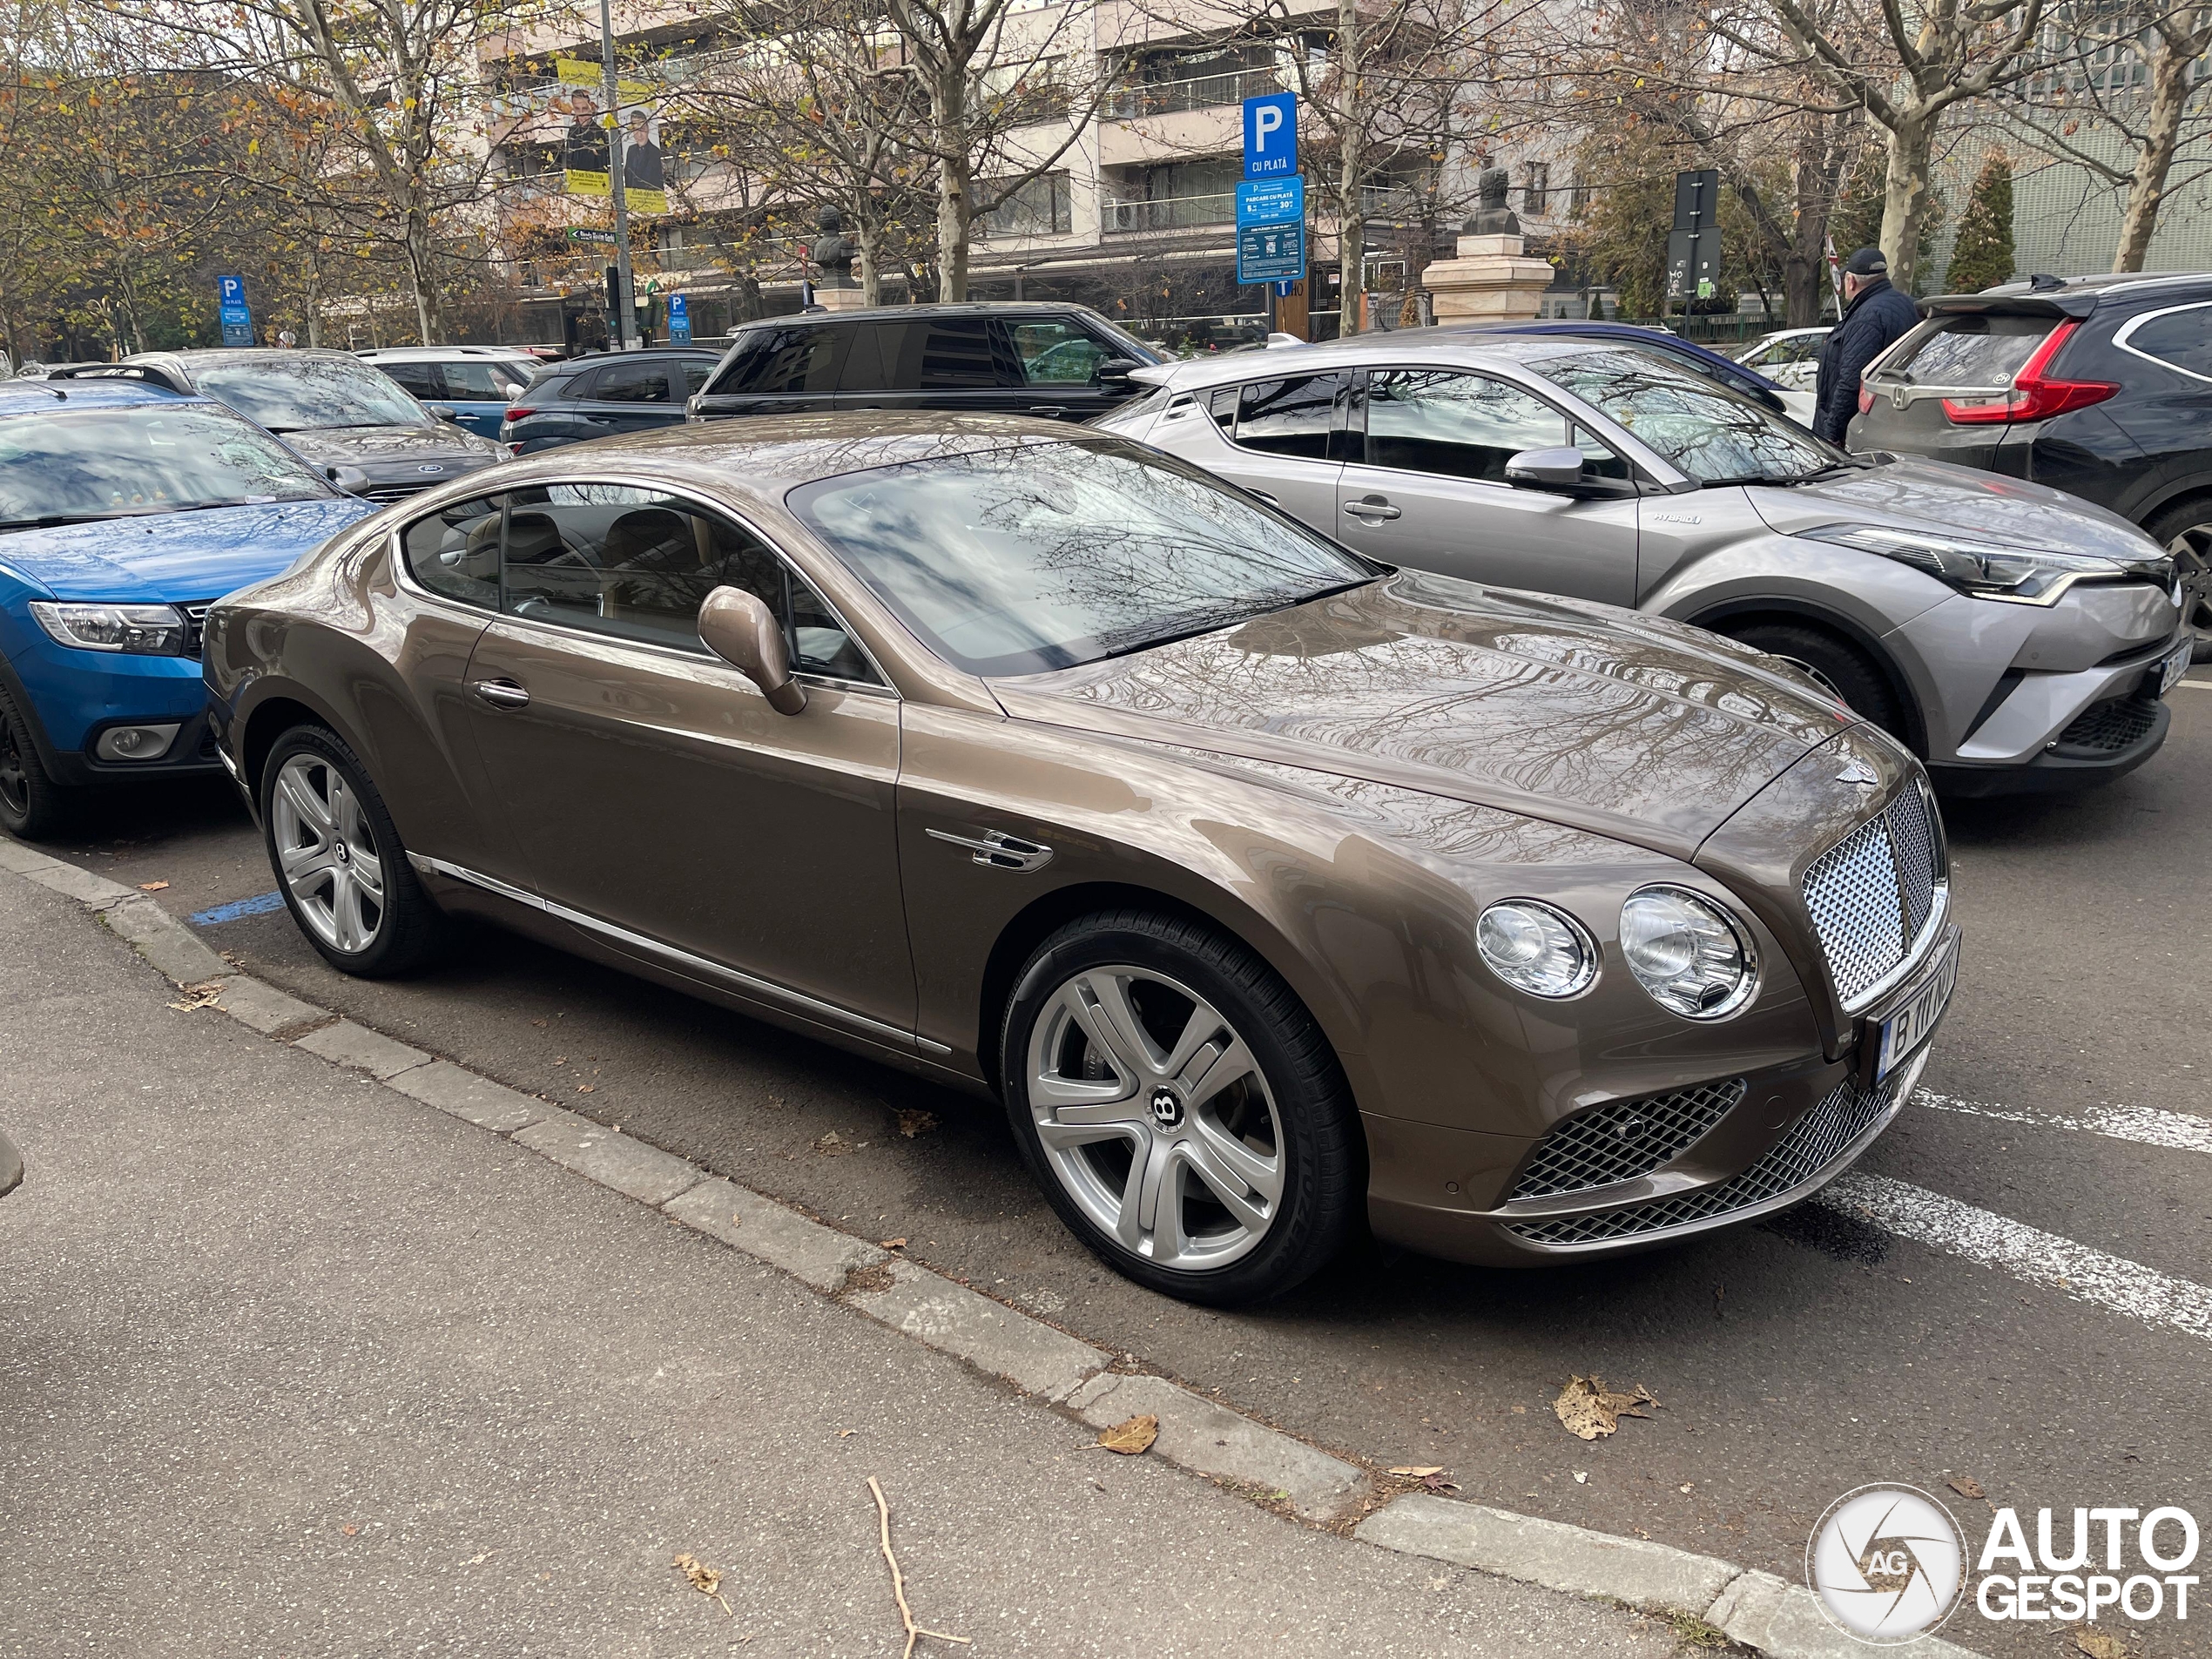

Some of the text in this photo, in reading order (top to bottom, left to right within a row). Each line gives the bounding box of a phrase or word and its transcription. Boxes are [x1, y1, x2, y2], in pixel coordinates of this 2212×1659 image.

[1256, 105, 1283, 152] P
[1252, 157, 1287, 172] CU PLATĂ
[224, 280, 237, 297] P
[672, 297, 681, 309] P
[1655, 513, 1694, 524] HYBRID
[1893, 1009, 1909, 1060] B
